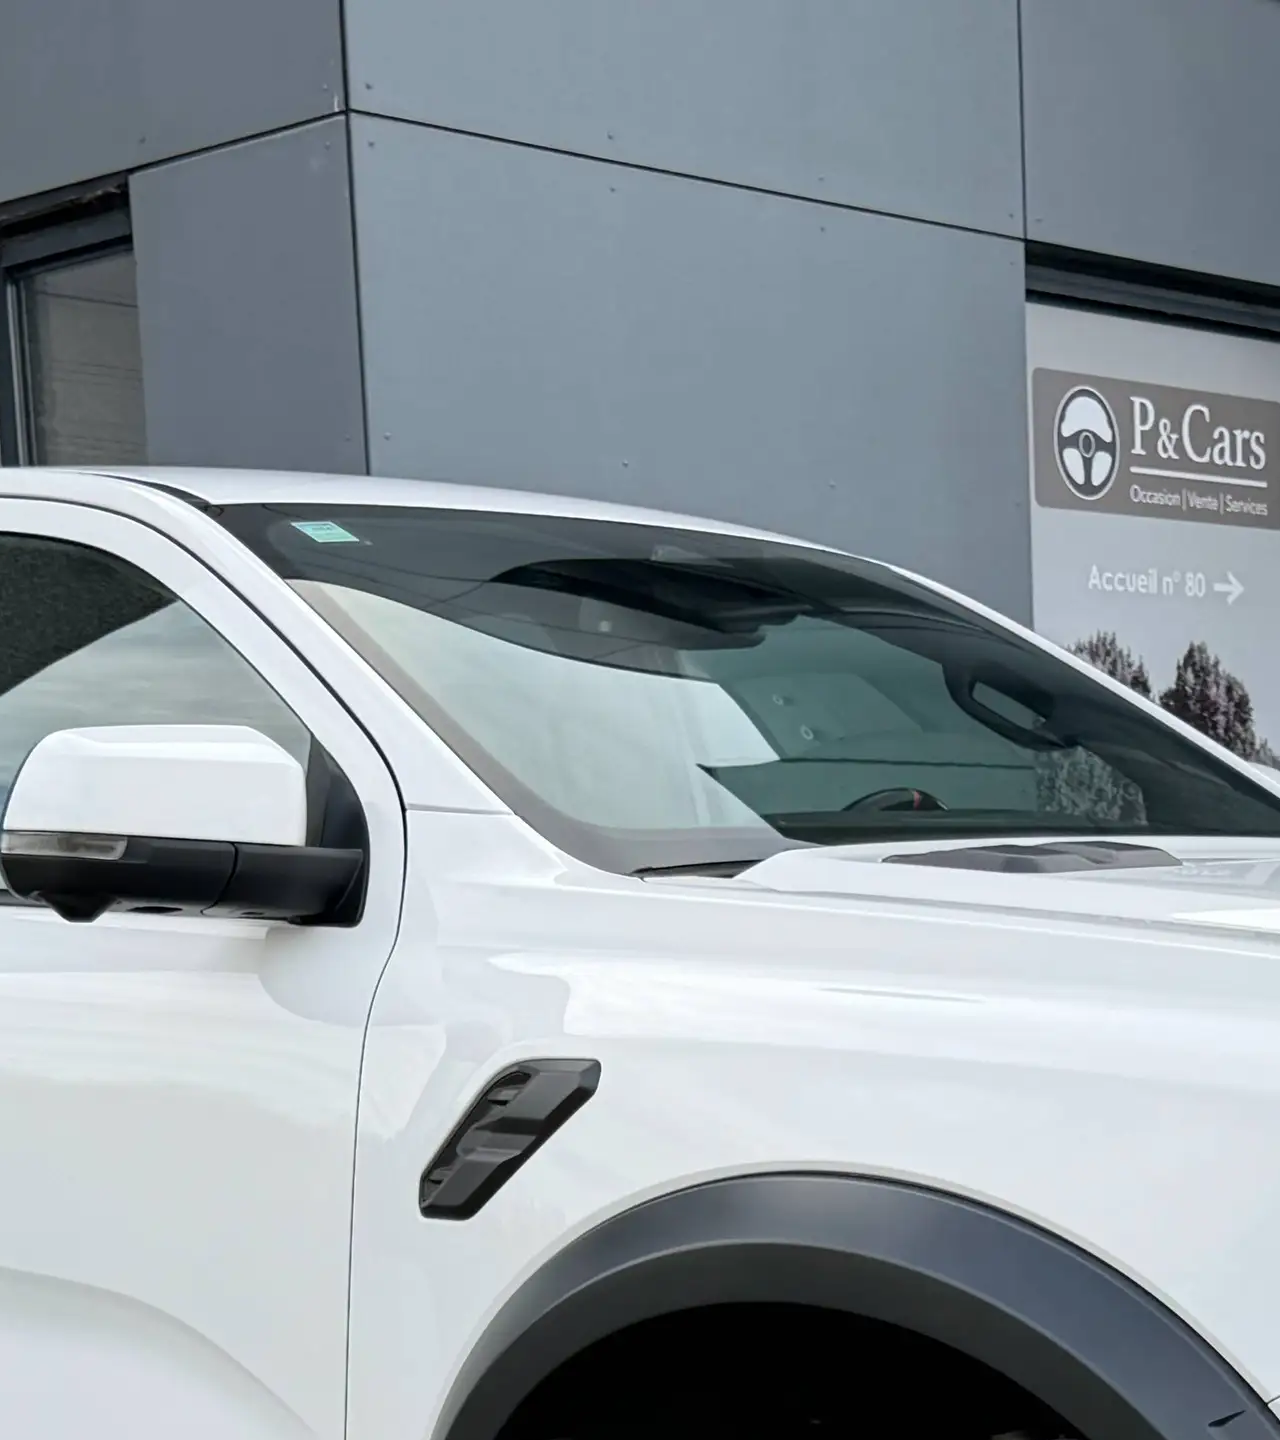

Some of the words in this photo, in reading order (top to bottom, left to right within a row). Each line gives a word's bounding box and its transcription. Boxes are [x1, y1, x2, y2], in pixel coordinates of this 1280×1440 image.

[1128, 395, 1267, 470] P&Cars
[1129, 484, 1181, 506] Occasion
[1186, 489, 1218, 511] Vente
[1225, 494, 1268, 517] Services
[1088, 564, 1157, 595] Accueil
[1185, 571, 1206, 598] 80
